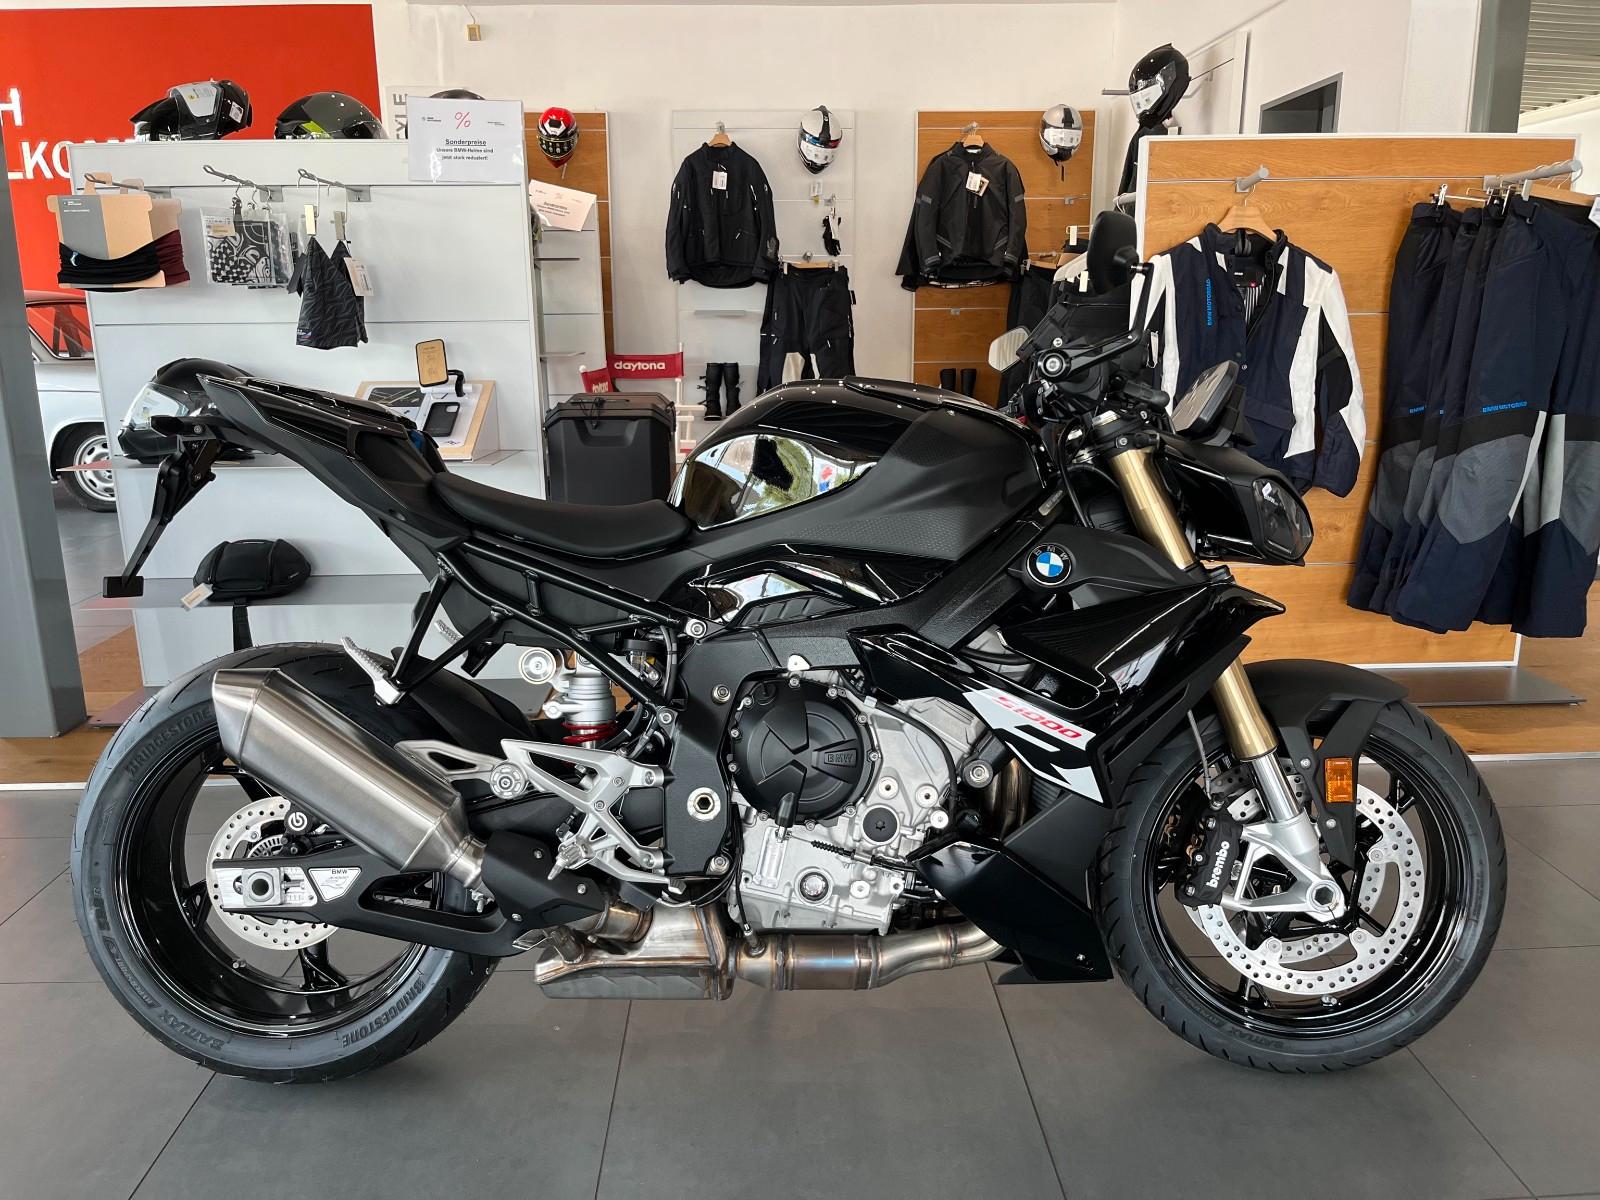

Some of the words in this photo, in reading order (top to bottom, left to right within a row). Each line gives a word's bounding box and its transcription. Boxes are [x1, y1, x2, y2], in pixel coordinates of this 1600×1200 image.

[445, 138, 487, 147] Sonderpreise
[614, 360, 666, 372] daytona
[827, 753, 854, 764] BMW
[1206, 841, 1230, 888] brembo
[341, 980, 426, 1049] BRIDGESTONE
